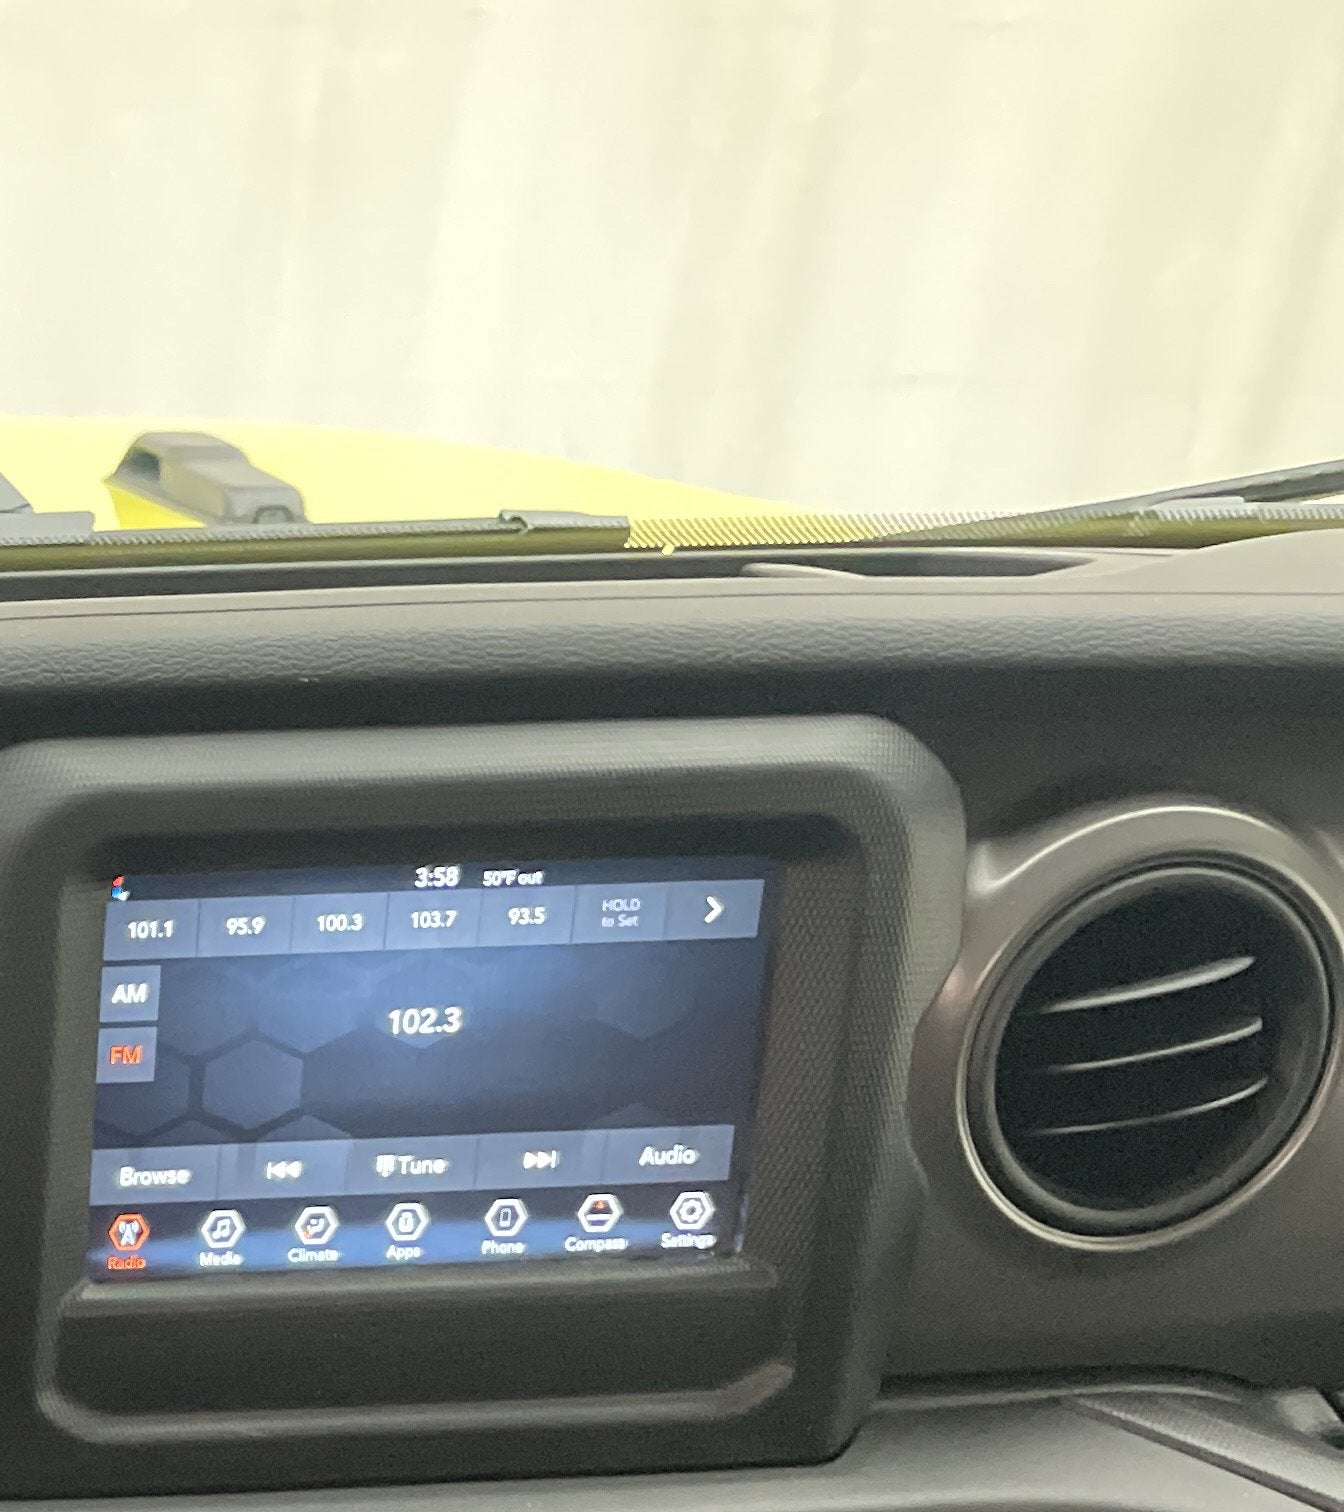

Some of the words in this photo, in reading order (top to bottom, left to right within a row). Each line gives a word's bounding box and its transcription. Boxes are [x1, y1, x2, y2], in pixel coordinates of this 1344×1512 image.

[414, 866, 459, 888] 3:58
[518, 871, 544, 885] out
[226, 916, 265, 935] 95.9
[317, 913, 363, 932] 100.3
[411, 910, 457, 929] 103.7
[508, 907, 546, 925] 93.5
[128, 920, 174, 939] 101.1
[111, 983, 148, 1006] AM
[388, 1007, 463, 1037] 102.3
[109, 1045, 143, 1067] FM
[638, 1144, 698, 1167] Audio
[397, 1155, 448, 1176] Tune
[119, 1167, 191, 1188] Browse
[386, 1244, 423, 1260] Apps
[481, 1240, 526, 1255] Phone
[564, 1236, 629, 1253] Compass
[107, 1255, 147, 1270] Radio
[199, 1252, 242, 1267] Media
[287, 1247, 340, 1263] Climate
